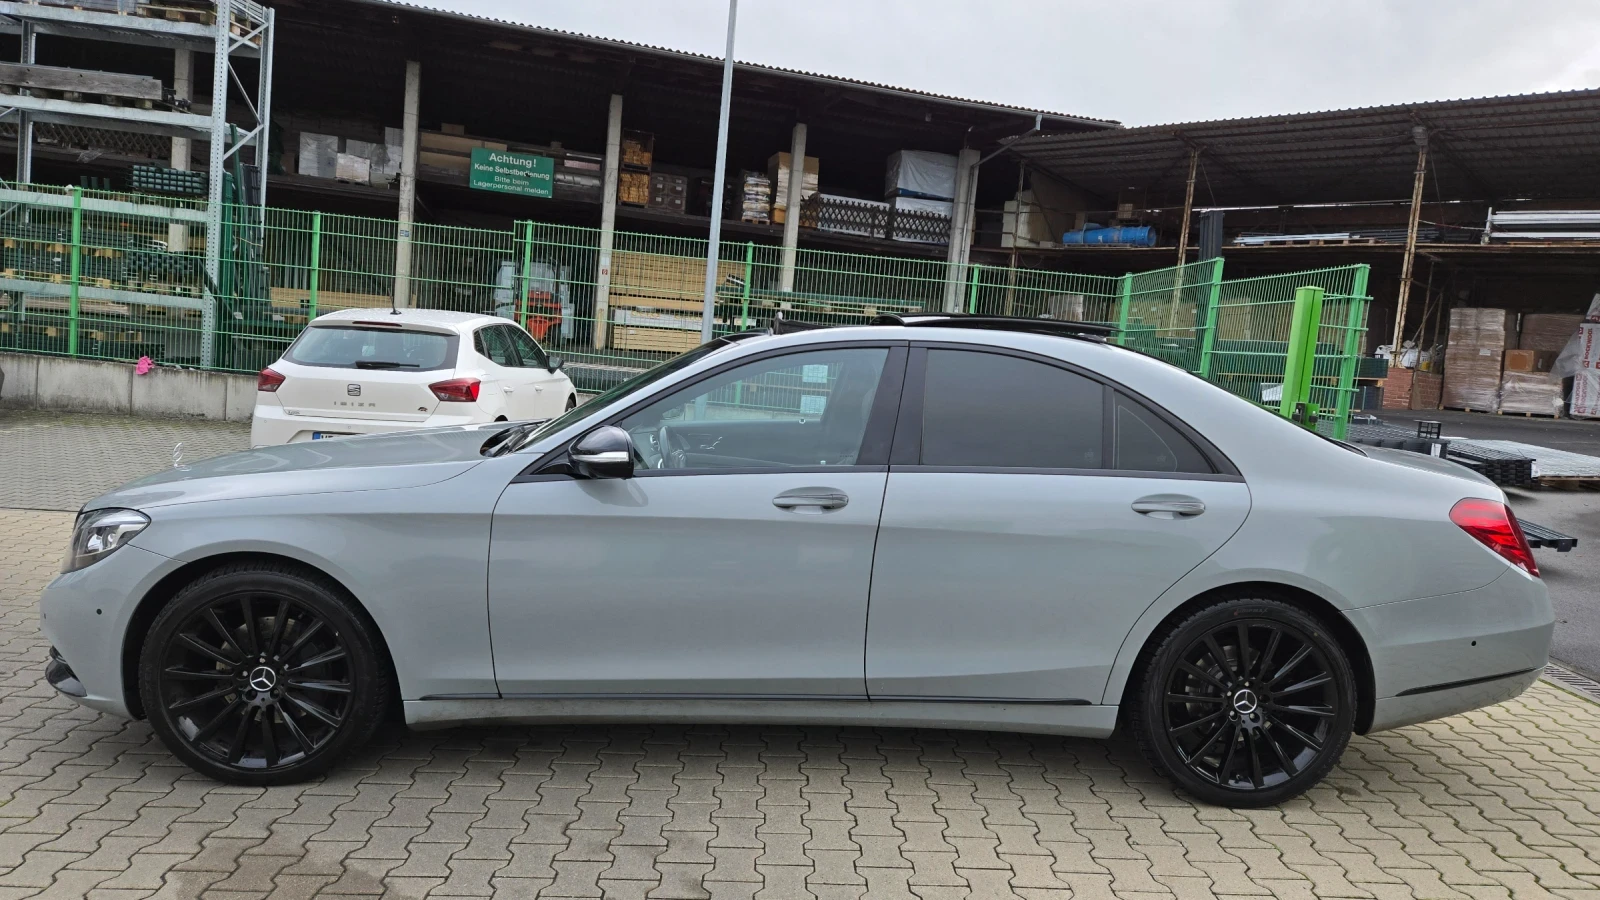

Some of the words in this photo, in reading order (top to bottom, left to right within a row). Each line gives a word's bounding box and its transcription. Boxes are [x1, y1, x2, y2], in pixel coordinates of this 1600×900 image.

[489, 153, 537, 168] Achtung!
[474, 163, 494, 172] Keine
[494, 165, 550, 181] Selbstbedienung
[473, 180, 522, 191] Lagerpersonal
[524, 187, 549, 195] melden
[494, 175, 511, 184] Bitte
[512, 178, 529, 186] beim
[1584, 328, 1593, 360] ROCKWOOL
